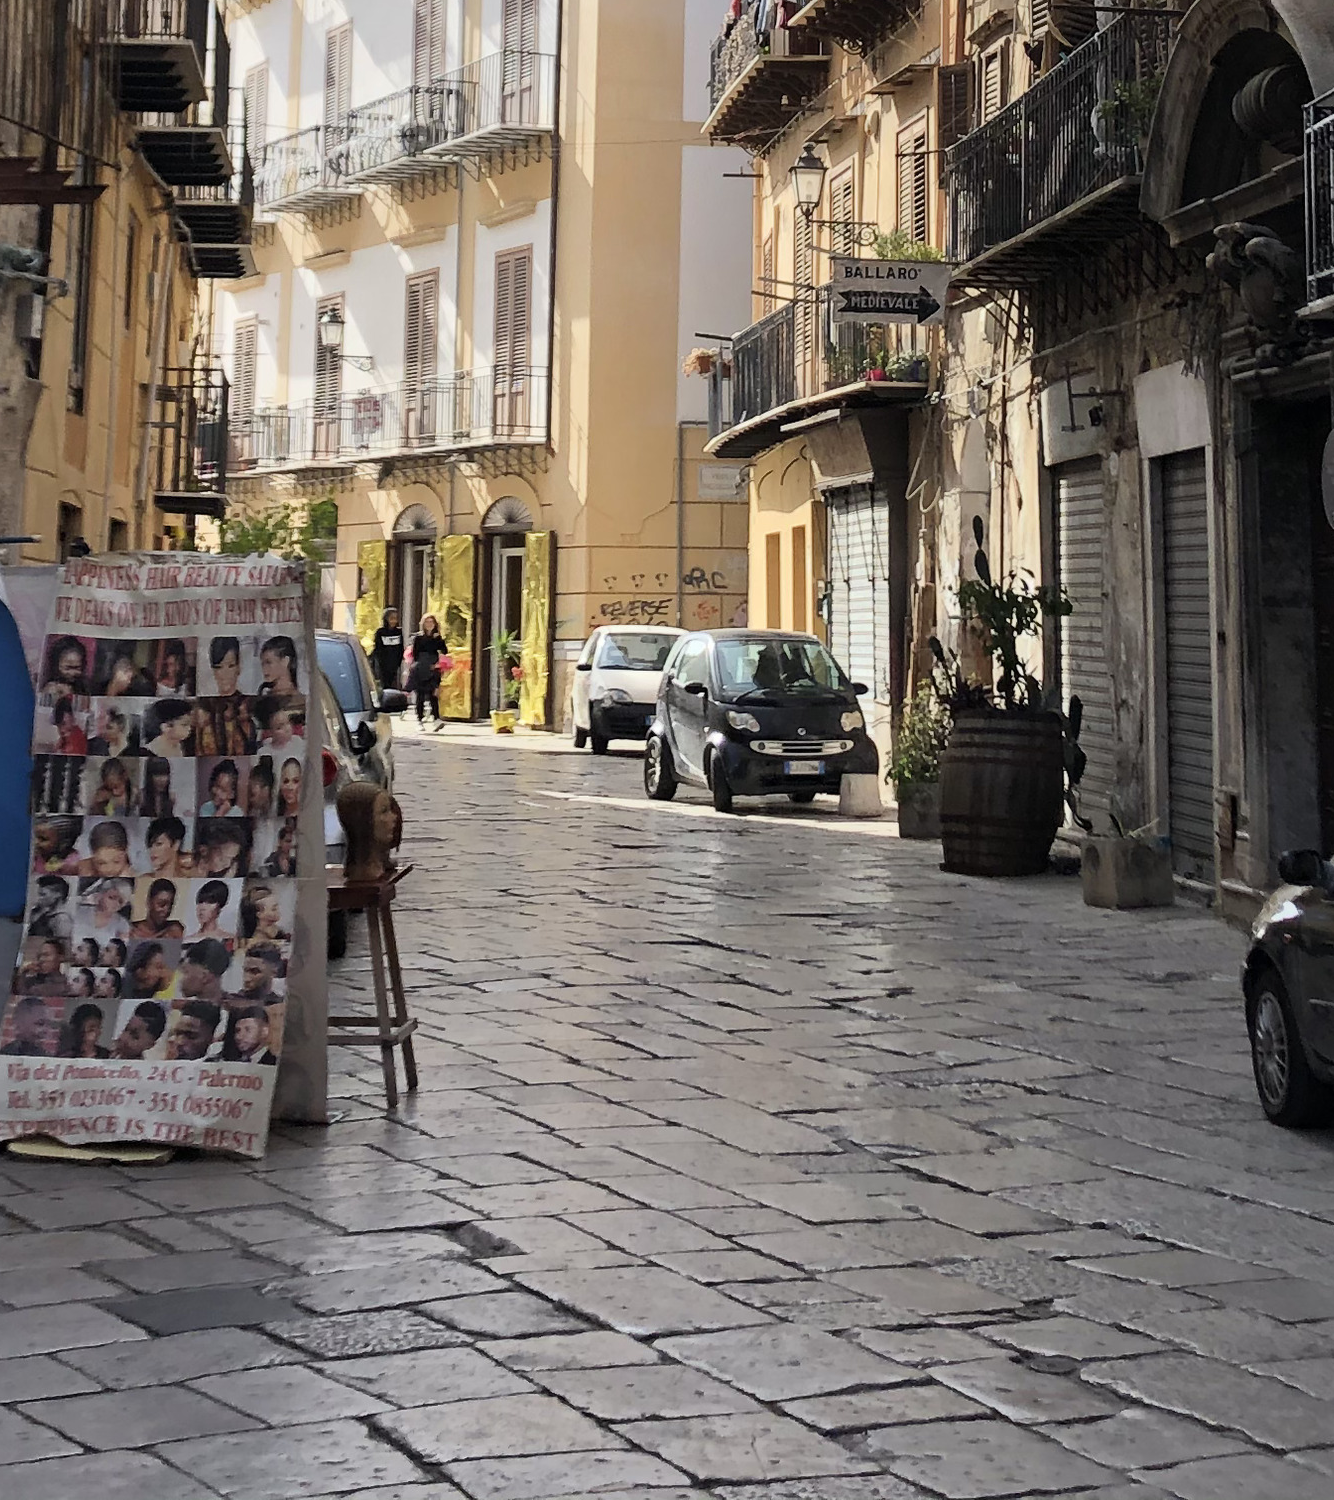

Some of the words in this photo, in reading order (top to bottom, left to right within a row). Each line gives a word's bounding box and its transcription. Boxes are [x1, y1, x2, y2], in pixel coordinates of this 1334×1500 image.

[850, 295, 920, 310] MEDIEVALE
[146, 566, 182, 590] HAIR
[183, 565, 244, 588] BEAUTY
[75, 598, 115, 627] DEALS
[203, 598, 222, 626] OF
[225, 598, 256, 625] HAIR
[197, 1068, 264, 1092] Palermo
[124, 1118, 145, 1136] IS
[153, 1121, 195, 1146] THE
[203, 1126, 259, 1152] BEST
